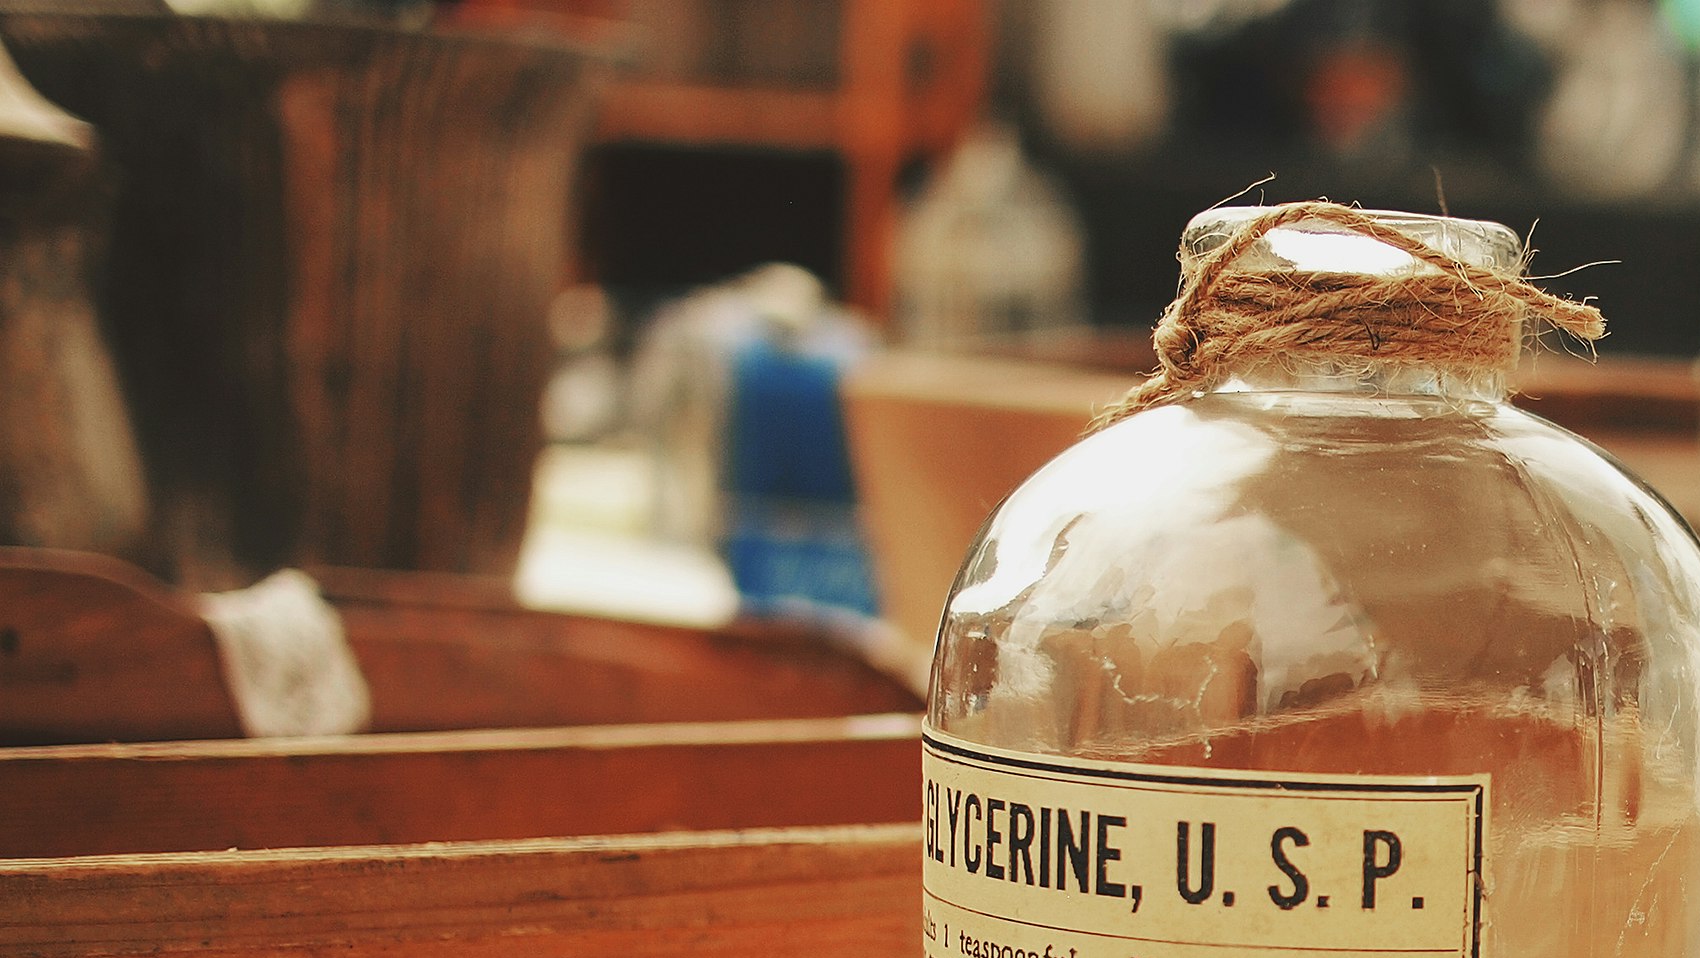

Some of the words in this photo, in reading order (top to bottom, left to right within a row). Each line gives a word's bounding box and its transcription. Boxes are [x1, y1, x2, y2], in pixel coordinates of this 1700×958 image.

[926, 778, 1142, 913] GLYCERINE,
[1176, 821, 1236, 907] U.
[1267, 827, 1330, 909] S.
[1360, 829, 1425, 910] P.
